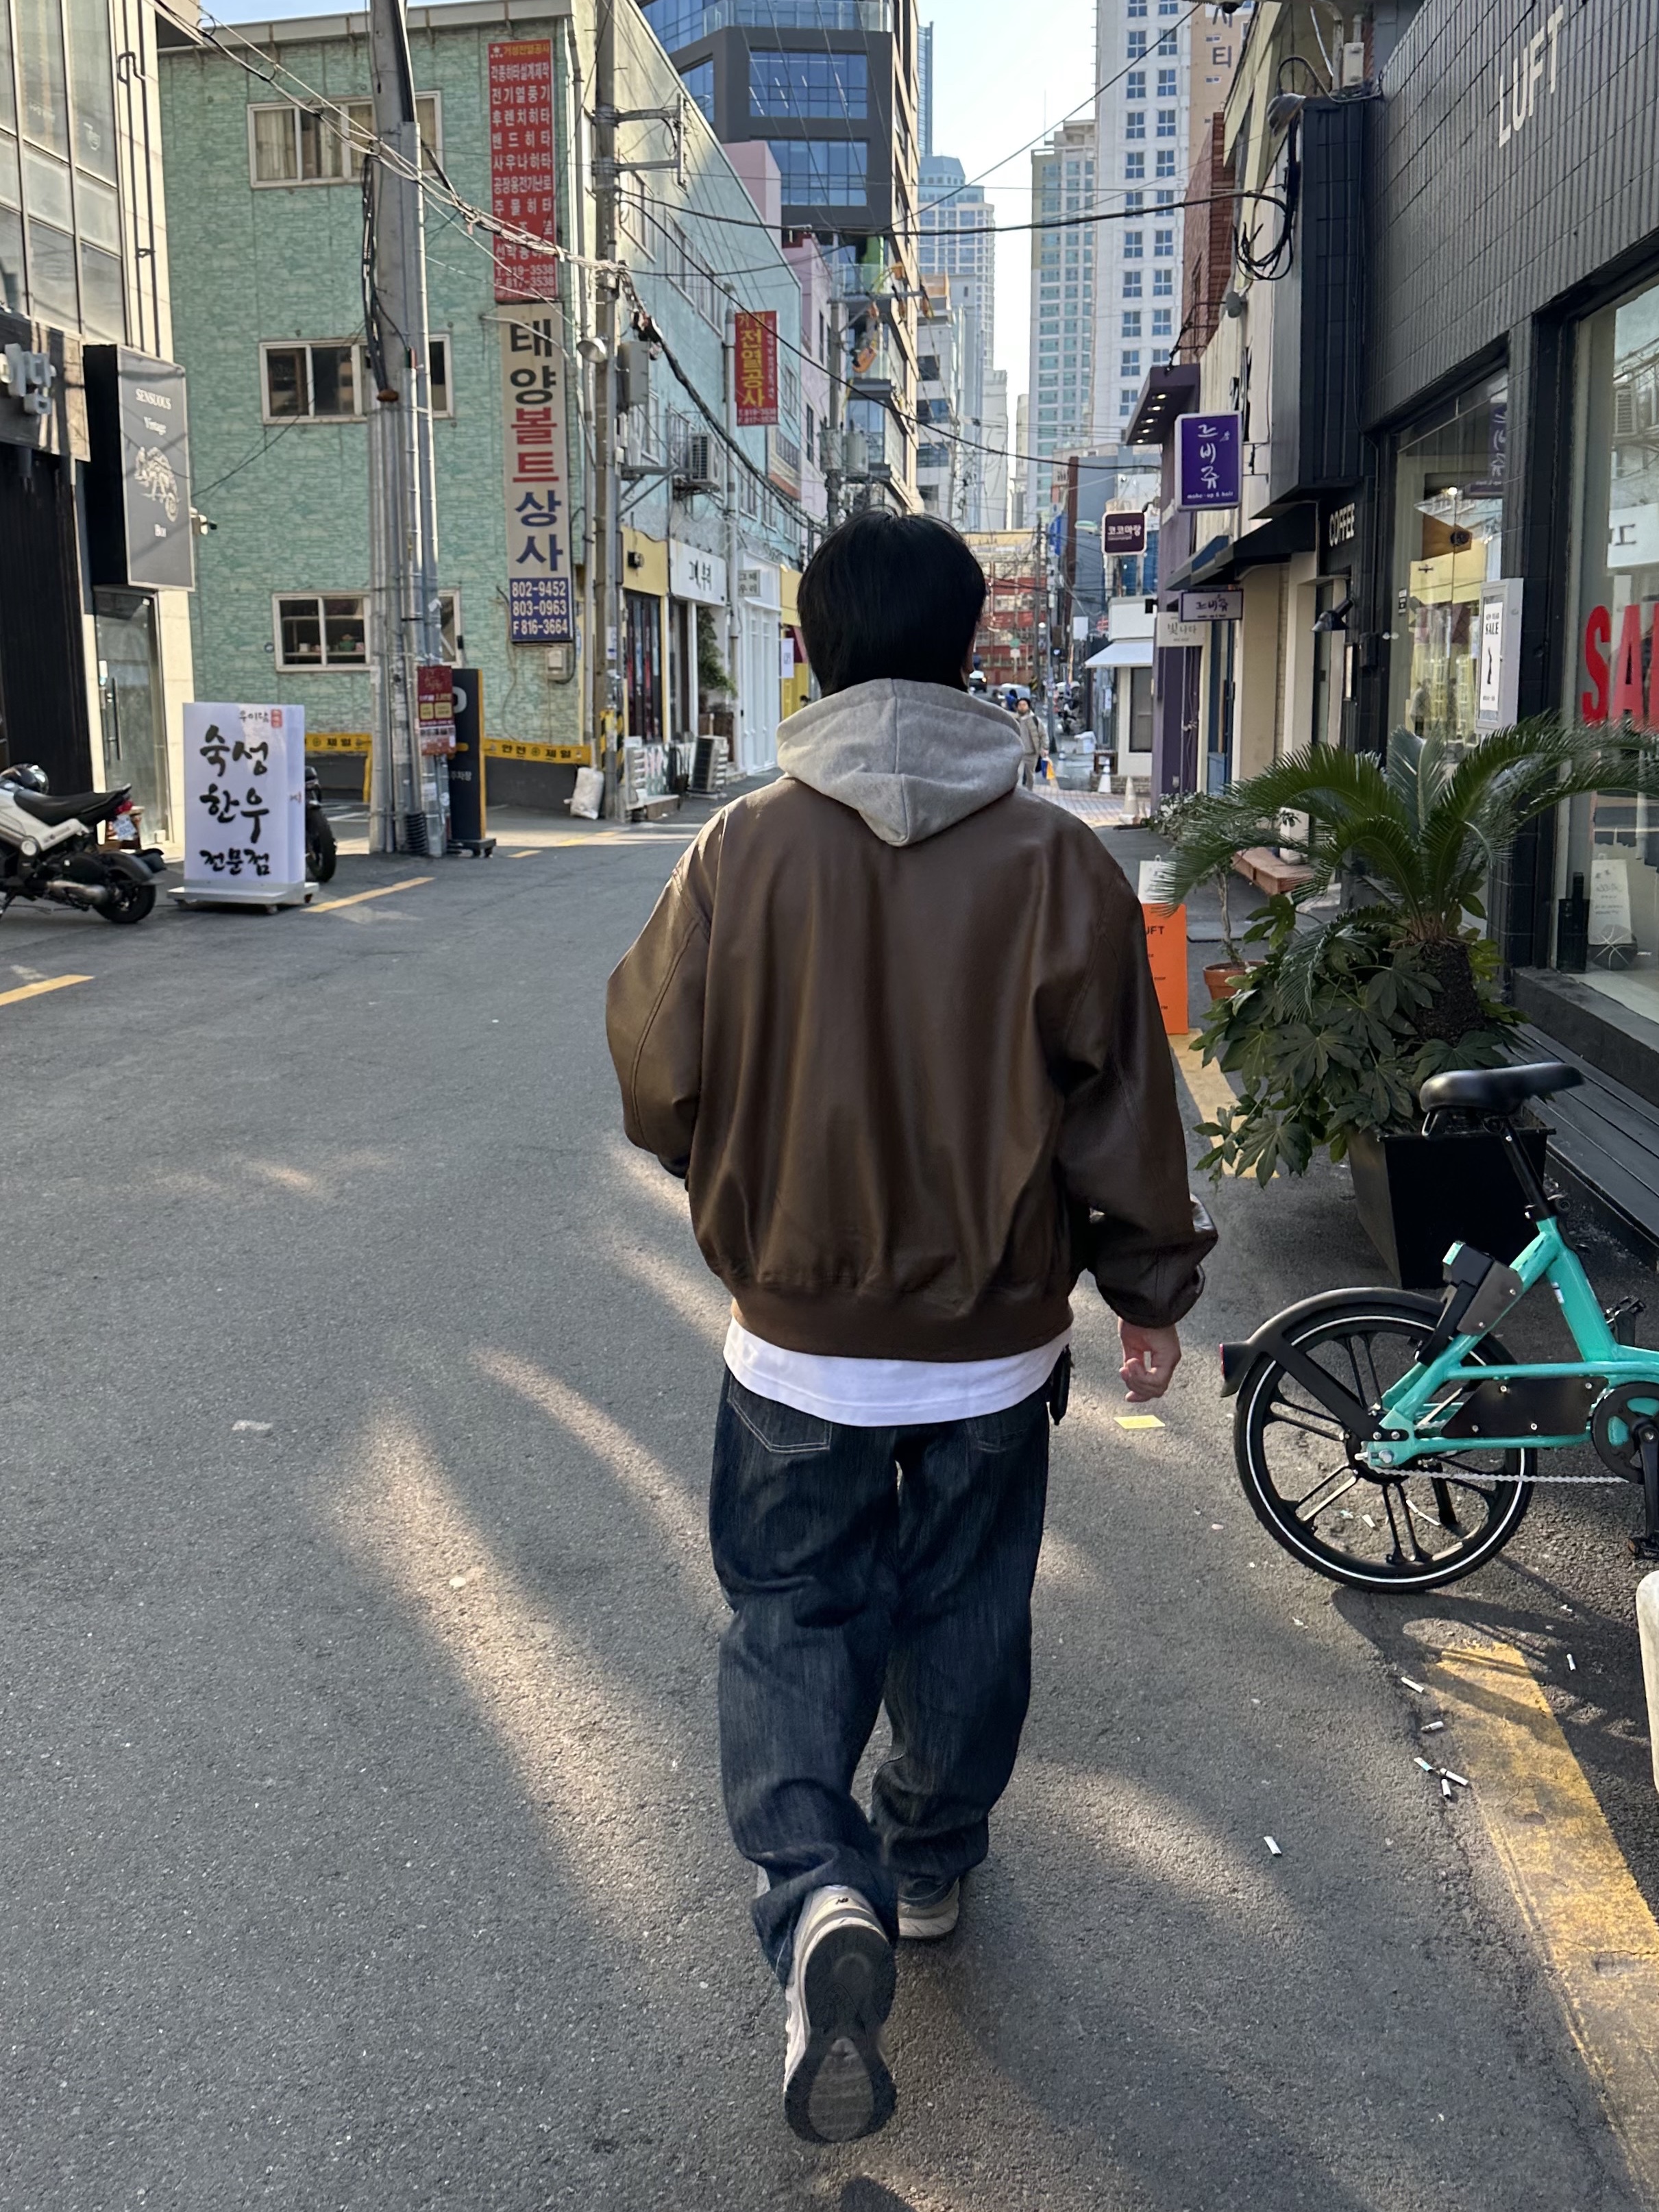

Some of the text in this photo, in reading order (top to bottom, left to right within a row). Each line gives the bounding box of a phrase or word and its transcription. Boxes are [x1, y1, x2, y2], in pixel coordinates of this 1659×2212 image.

[1499, 4, 1564, 148] LUFT
[492, 85, 550, 105] 전기열풍기
[492, 108, 550, 127] 후렌치히타
[493, 152, 552, 171] 사우나히타
[494, 175, 552, 195] 공장용전기난로
[510, 319, 563, 572] 태양볼트상사
[1329, 502, 1355, 547] COFFEE
[512, 581, 566, 598] 802-9452
[513, 599, 567, 616] 803-0963
[521, 619, 567, 635] 816-3664
[1485, 622, 1499, 635] SALE
[1582, 602, 1659, 734] SA
[199, 724, 269, 777] 숙성
[199, 783, 270, 844] 한우
[199, 847, 271, 876] 전문점
